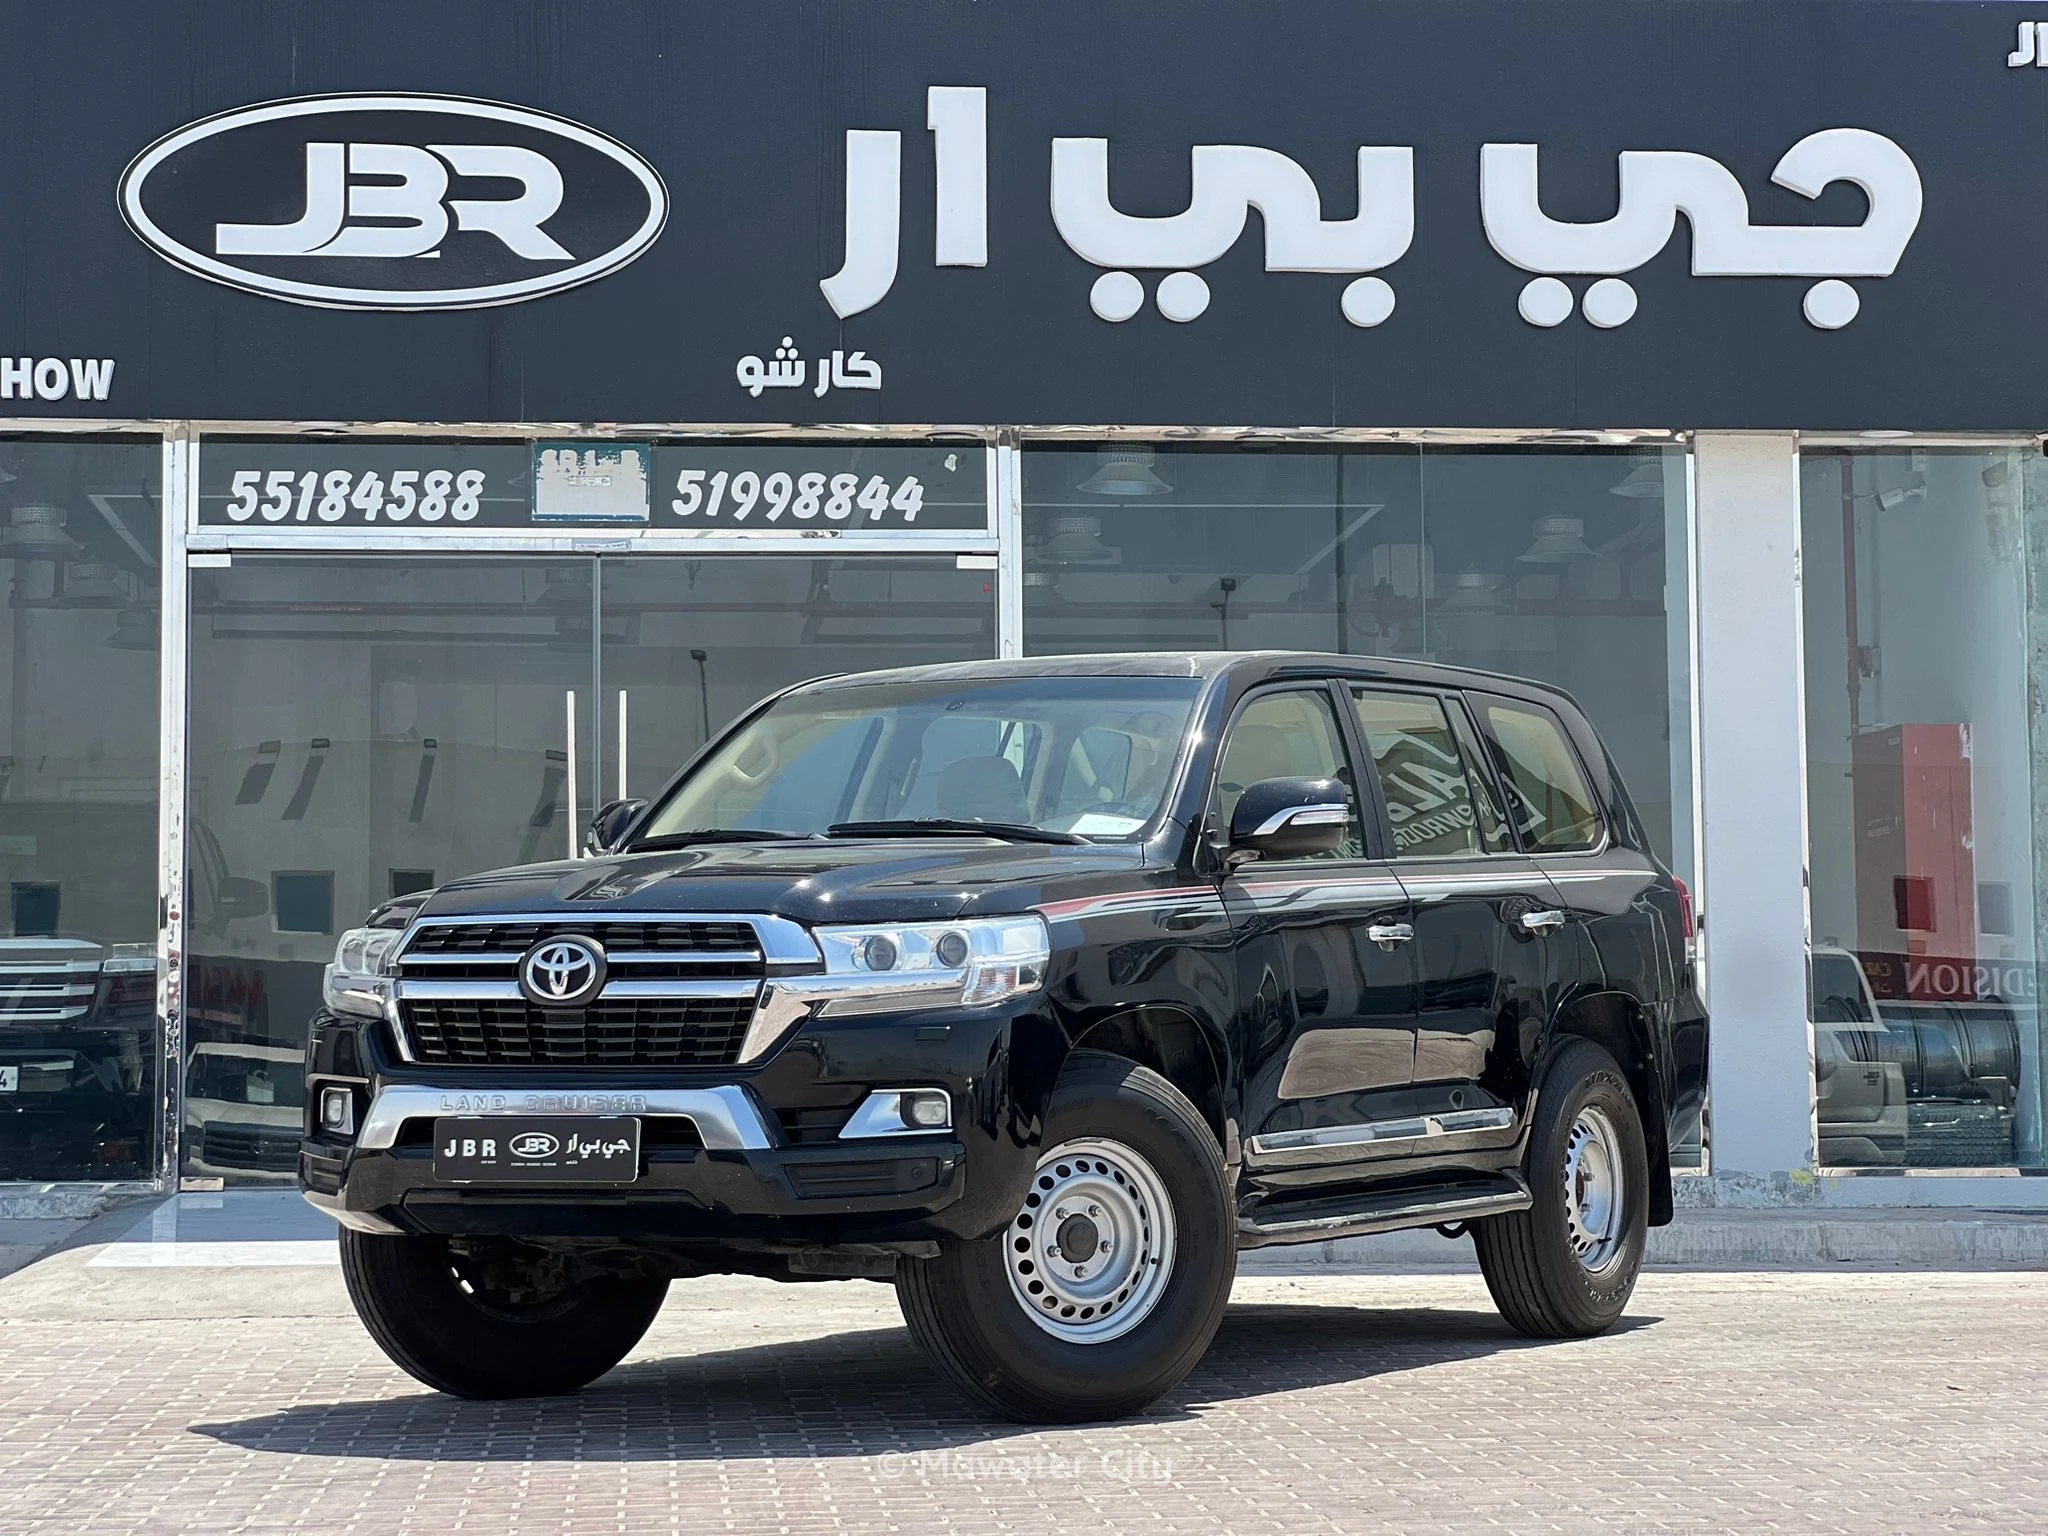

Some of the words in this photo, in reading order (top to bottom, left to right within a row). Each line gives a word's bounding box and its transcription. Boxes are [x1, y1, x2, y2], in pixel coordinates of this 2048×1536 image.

[216, 142, 576, 261] JBR
[819, 85, 988, 320] ار
[1050, 136, 1414, 328] بي
[1480, 127, 1923, 330] جي
[0, 357, 115, 401] HOW
[736, 336, 806, 398] شو
[814, 350, 882, 398] كار
[227, 469, 486, 522] 55184588
[671, 469, 925, 522] 51998844
[440, 1094, 507, 1111] LAND
[524, 1094, 647, 1112] CRUISER
[517, 1138, 551, 1153] JBR
